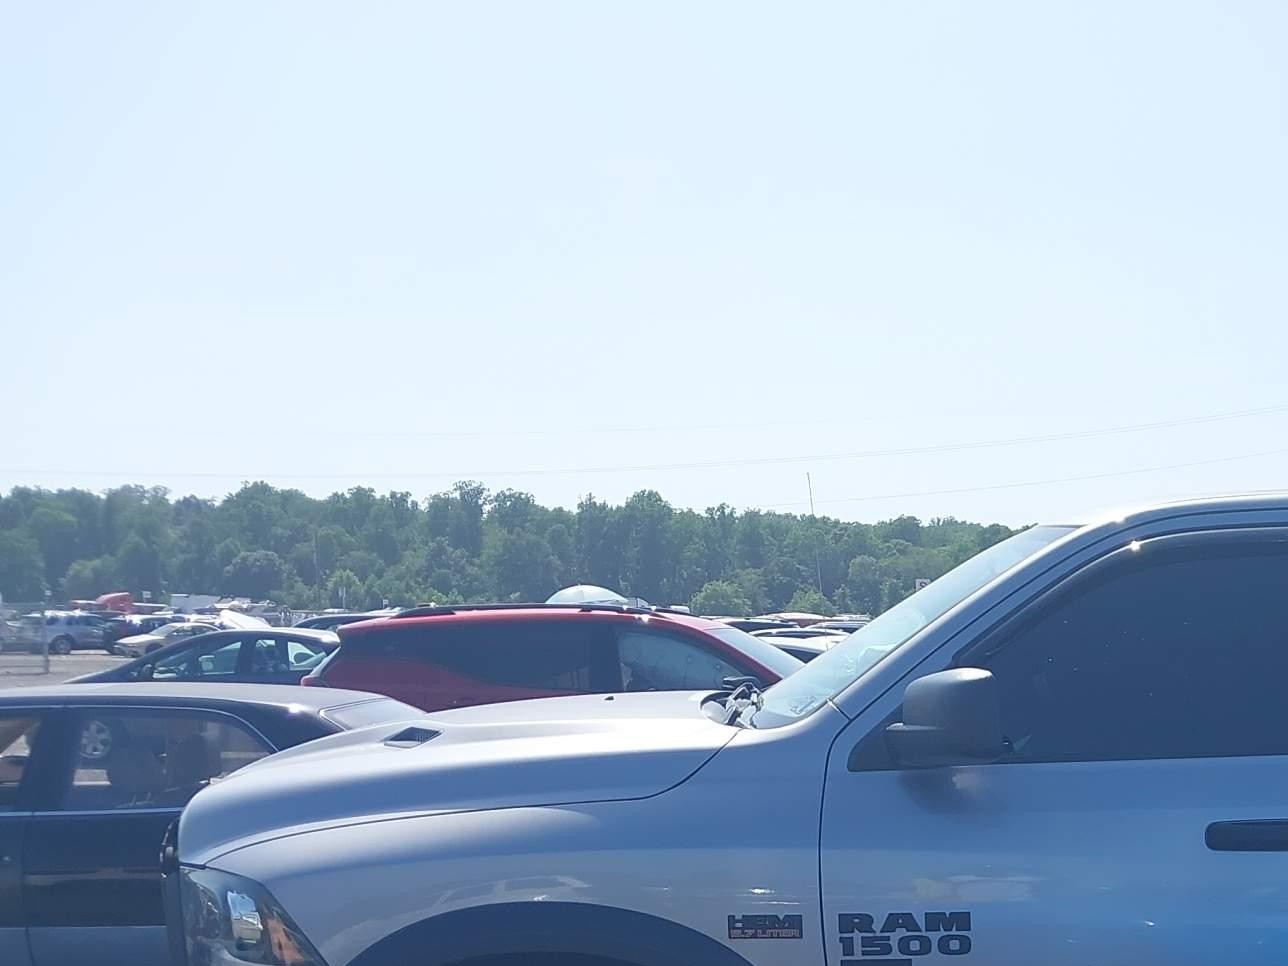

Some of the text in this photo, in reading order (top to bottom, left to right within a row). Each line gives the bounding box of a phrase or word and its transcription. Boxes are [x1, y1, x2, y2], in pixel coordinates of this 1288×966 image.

[727, 914, 803, 929] HEMI
[838, 912, 972, 934] RAM
[839, 934, 972, 957] 1500
